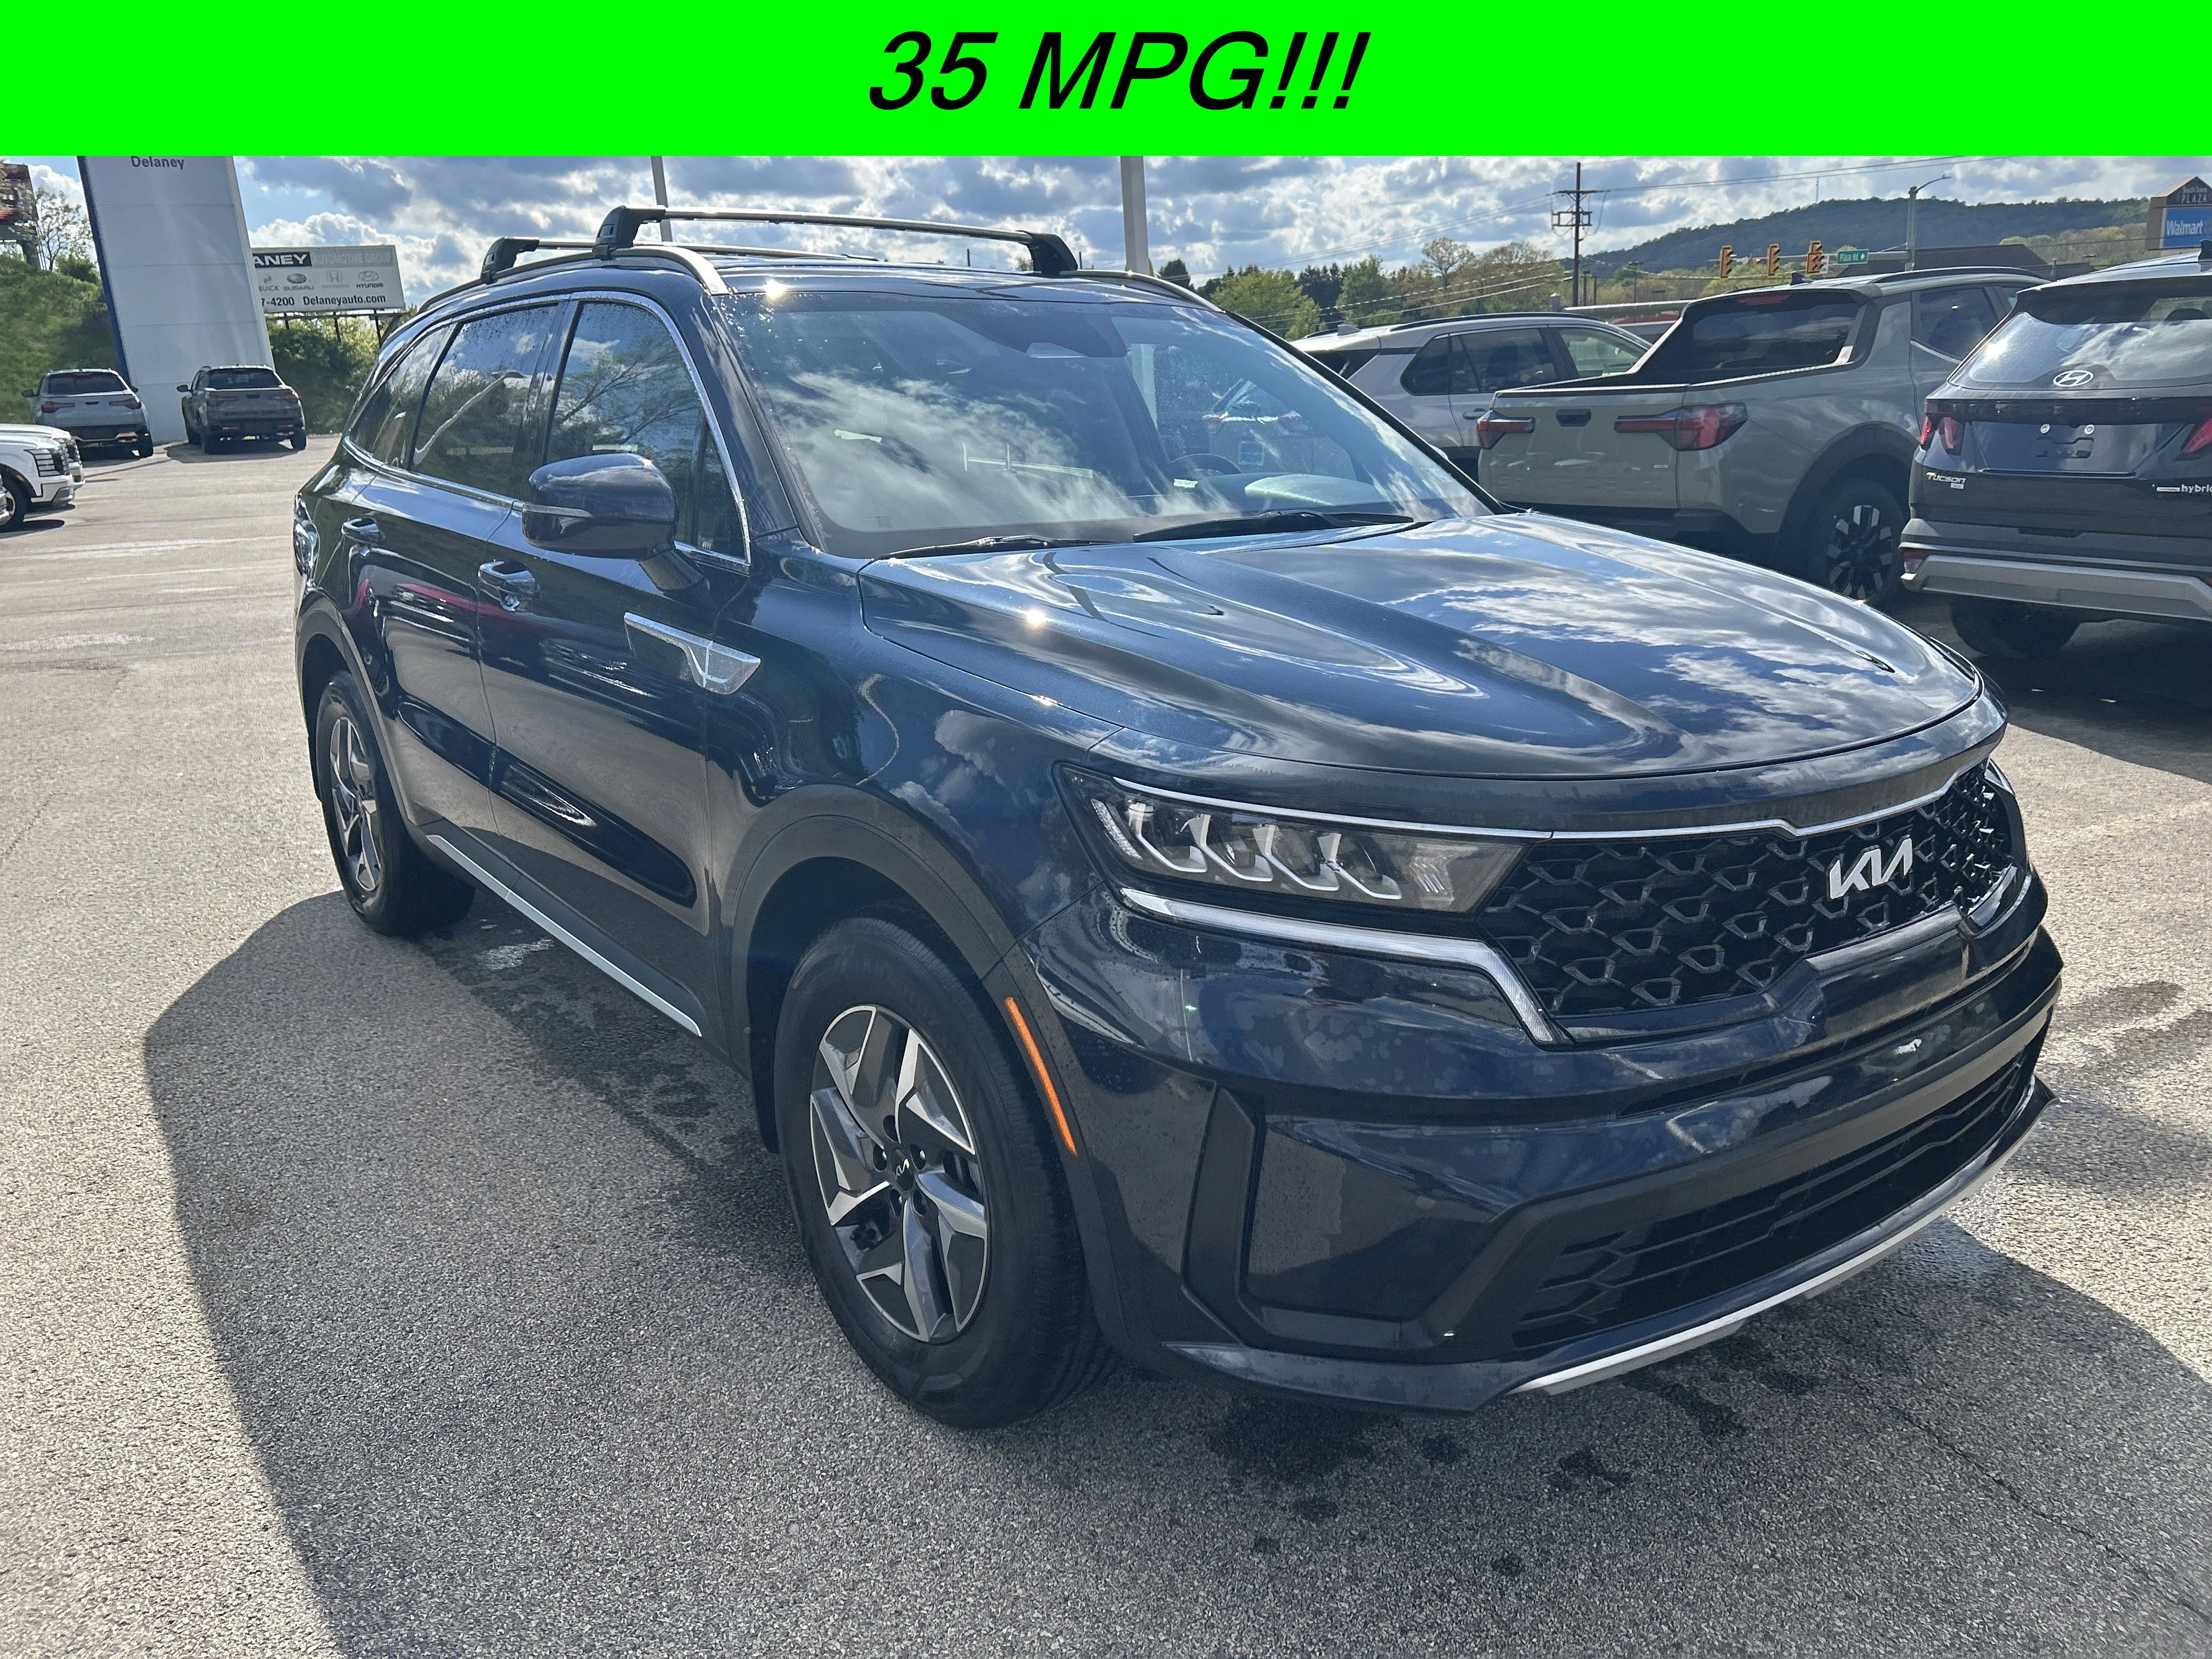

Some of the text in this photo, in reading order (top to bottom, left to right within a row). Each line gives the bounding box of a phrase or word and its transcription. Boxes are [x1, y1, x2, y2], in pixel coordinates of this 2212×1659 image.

[130, 156, 184, 170] Delaney
[2181, 194, 2207, 204] PLAZA
[2166, 219, 2203, 236] Walmart
[303, 295, 386, 306] Delaneyauto.com
[1829, 837, 1913, 899] KIA
